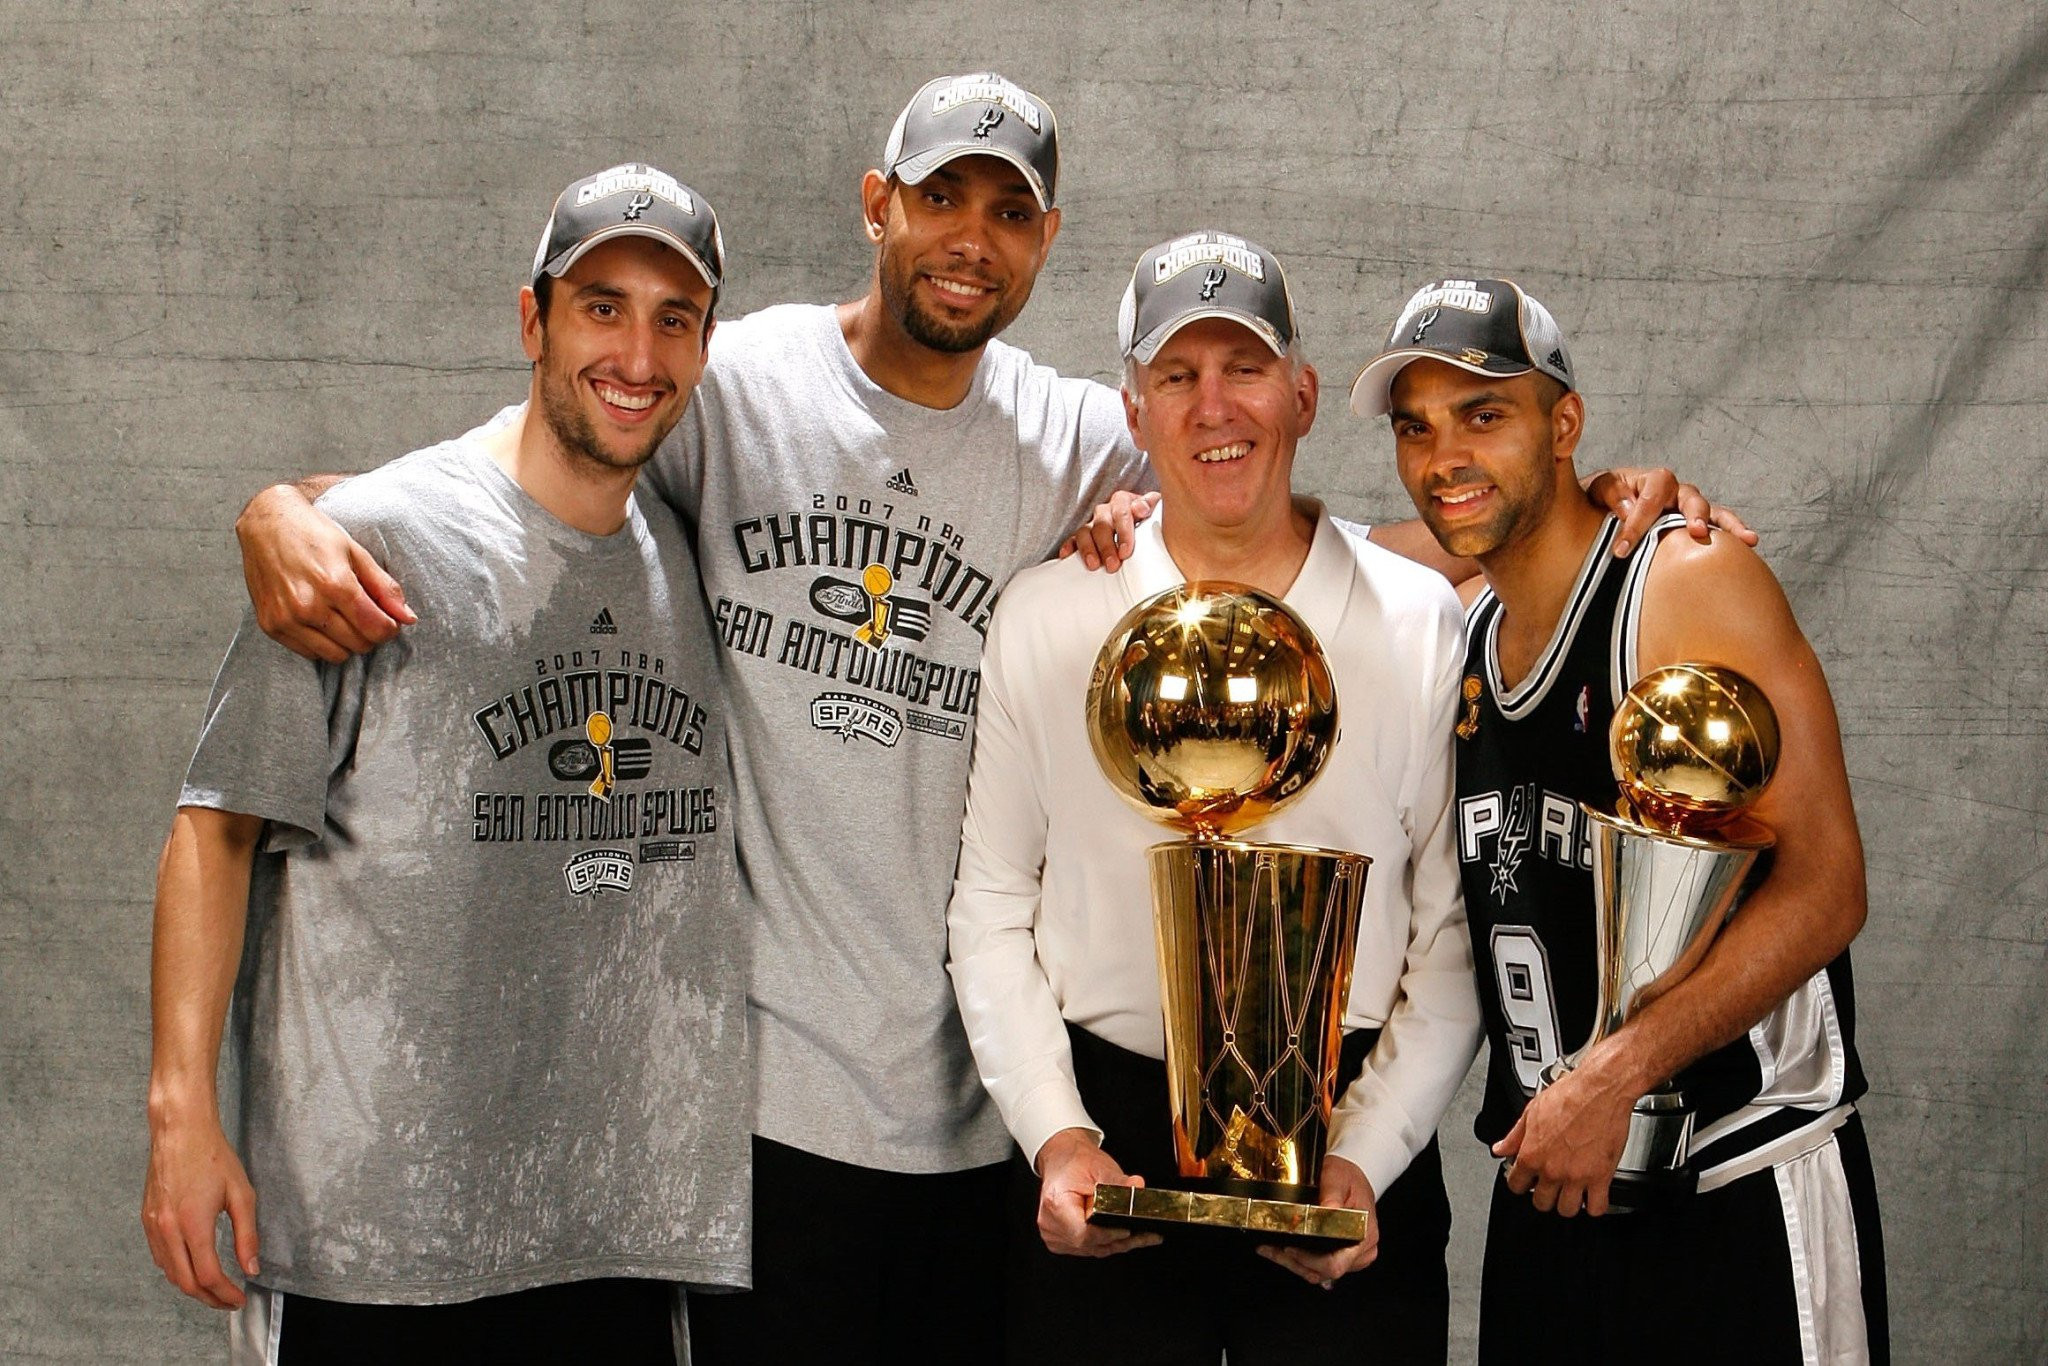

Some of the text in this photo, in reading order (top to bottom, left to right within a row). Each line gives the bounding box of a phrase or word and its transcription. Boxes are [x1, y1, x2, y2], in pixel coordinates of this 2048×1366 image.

[1155, 243, 1264, 285] CHAMPIONS
[1391, 289, 1491, 343] MPIONS
[886, 479, 918, 497] adidas
[813, 494, 964, 551] 2007 NBA
[590, 626, 617, 634] adidas
[715, 595, 980, 716] SAN ANTONIO SPUR
[535, 650, 664, 676] 2007 NBA
[473, 669, 707, 760] CHAMPIONS
[819, 704, 895, 739] SPURS
[473, 787, 717, 841] SAN ANTONIO SPURS
[1459, 783, 1593, 872] PUR
[574, 862, 631, 886] SPURS
[1489, 924, 1564, 1098] 9
